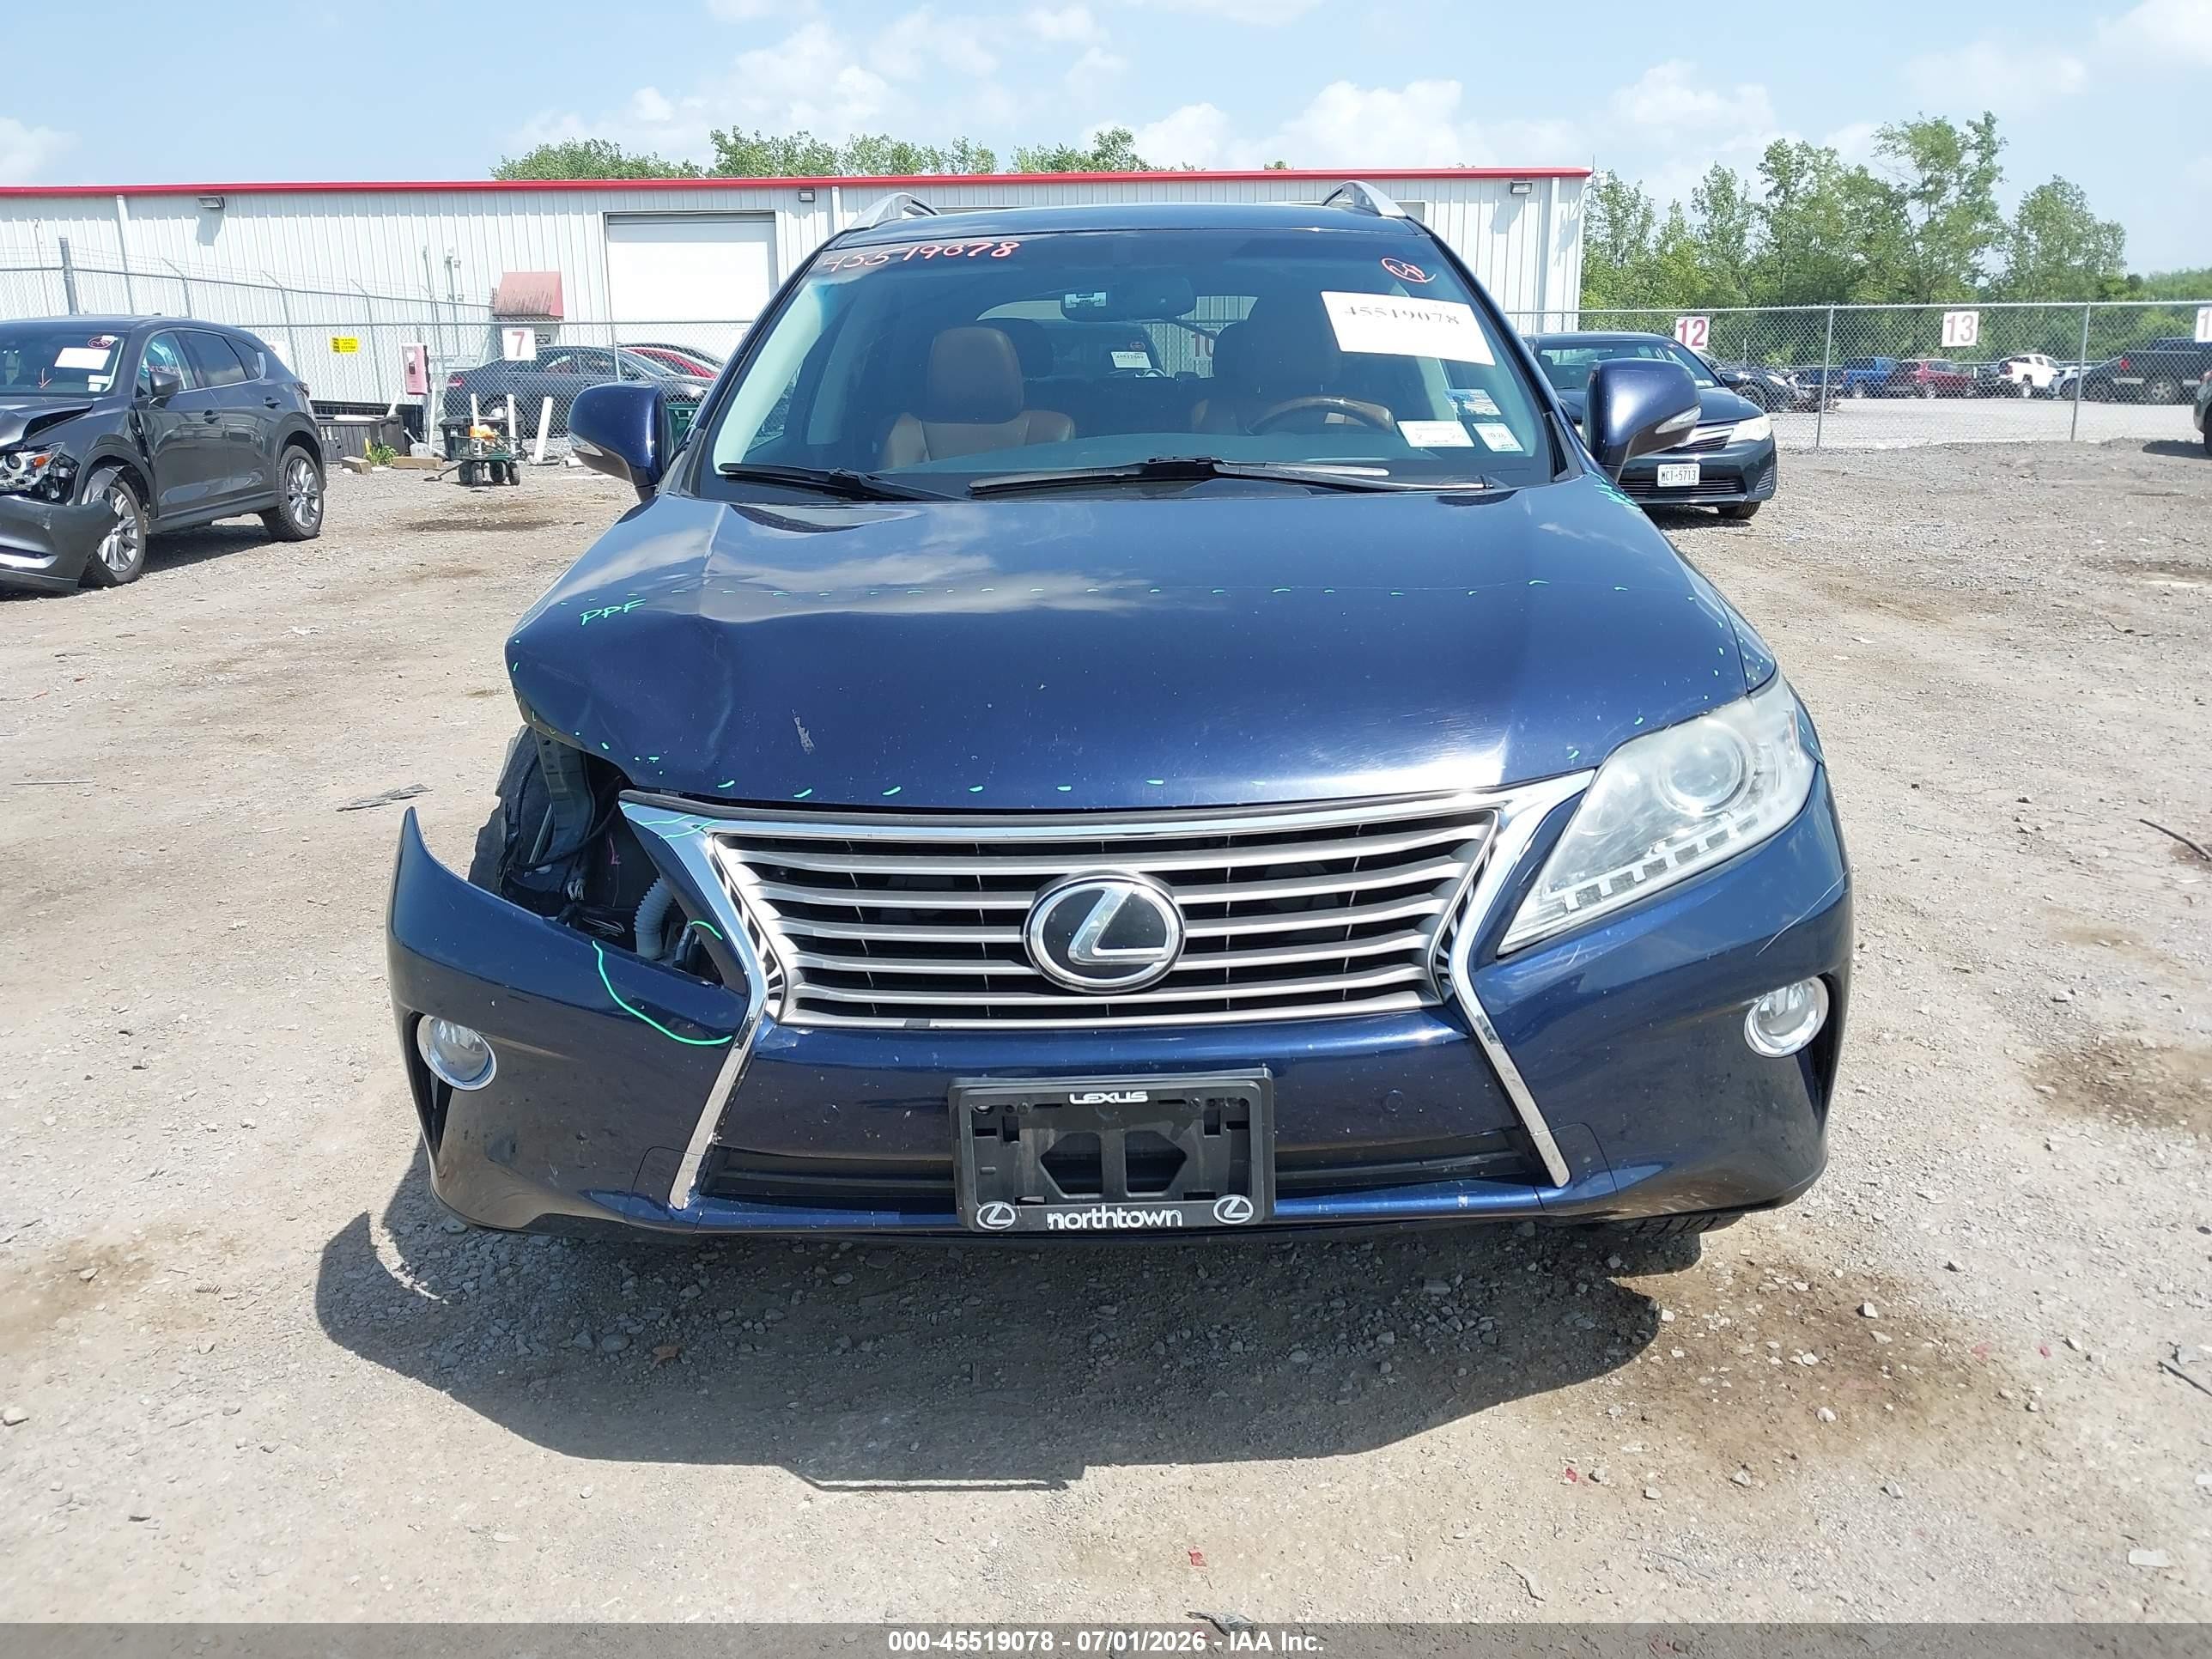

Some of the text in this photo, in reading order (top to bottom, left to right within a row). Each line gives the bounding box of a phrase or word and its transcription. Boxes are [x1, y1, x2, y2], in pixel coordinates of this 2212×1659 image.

[823, 241, 1020, 272] 45519078
[1677, 319, 1706, 346] 12
[1946, 314, 1974, 343] 13
[2200, 309, 2212, 338] 1
[512, 331, 525, 356] 7
[579, 599, 647, 625] PPF
[1069, 1091, 1148, 1104] LEXUS
[1047, 1205, 1183, 1231] northtown
